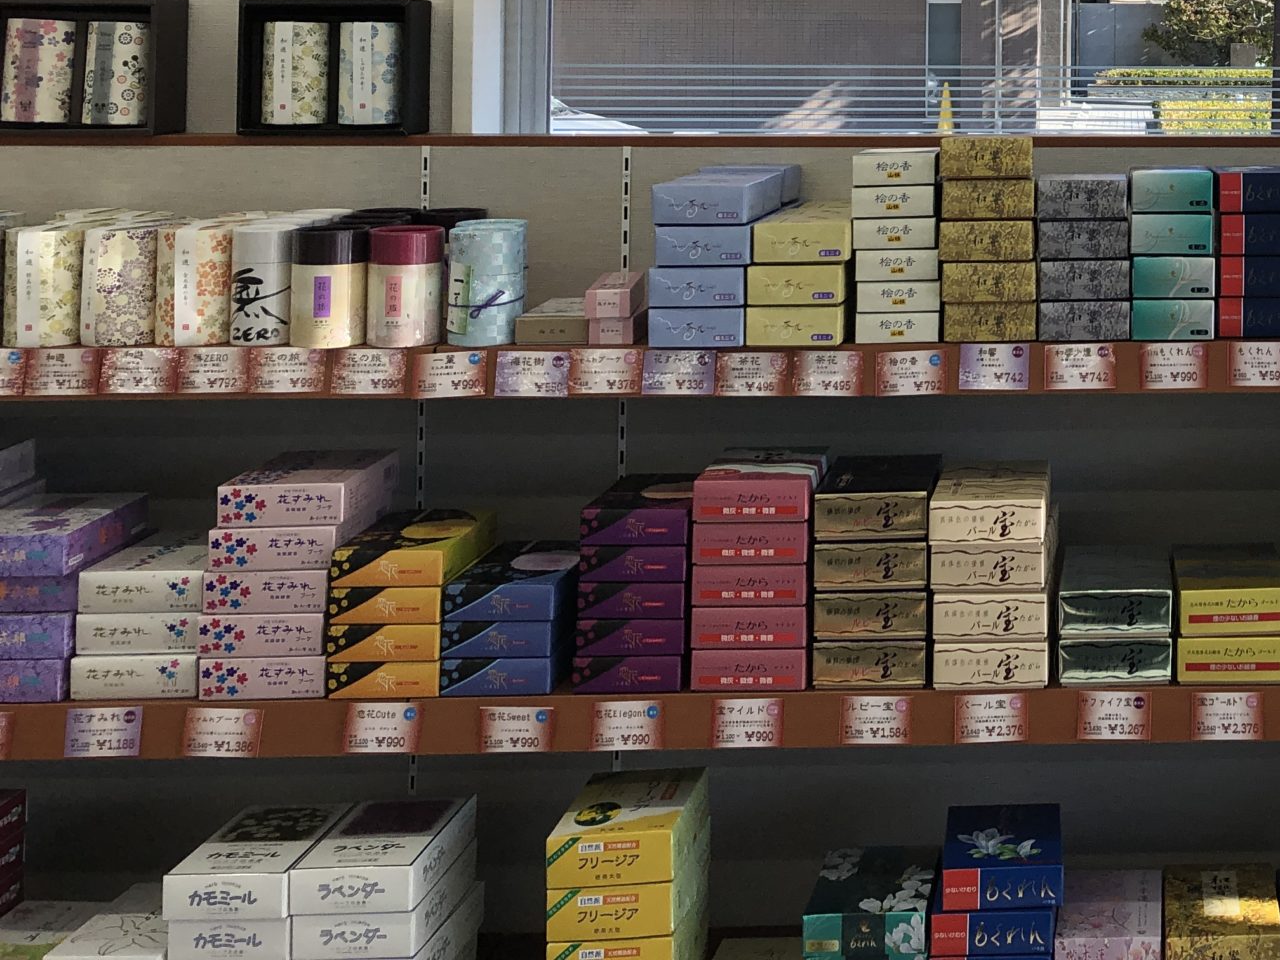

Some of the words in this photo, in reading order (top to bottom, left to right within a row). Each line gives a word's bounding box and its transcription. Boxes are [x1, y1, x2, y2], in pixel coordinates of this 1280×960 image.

[233, 268, 290, 325] 無
[232, 327, 280, 341] ZERO
[1238, 347, 1272, 356] もくれん
[264, 353, 300, 362] 花の旅
[347, 353, 382, 362] 花の旅
[738, 356, 760, 366] 茶花
[816, 355, 838, 364] 茶花
[290, 378, 318, 387] ¥990
[994, 372, 1023, 383] ¥742
[1079, 372, 1108, 382] ¥742
[1170, 372, 1198, 382] ¥990
[370, 378, 400, 388] ¥990
[451, 379, 479, 390] ¥990
[746, 381, 774, 392] ¥495
[822, 380, 851, 390] ¥495
[914, 381, 942, 391] ¥792
[278, 494, 332, 505] 花すみれ
[737, 493, 770, 504] たから
[877, 502, 898, 528] 宝
[269, 538, 324, 548] 花すみれ
[736, 535, 768, 545] たから
[876, 552, 898, 579] 宝
[263, 582, 314, 592] 花すみれ
[736, 578, 768, 587] たから
[876, 603, 897, 629] 宝
[1121, 600, 1143, 626] 宝
[257, 625, 311, 635] 花すみれ
[735, 621, 768, 631] たから
[1121, 648, 1142, 675] 宝
[258, 668, 314, 678] 花すみれ
[734, 664, 768, 674] たから
[848, 702, 894, 712] ルビー宝
[960, 700, 1006, 709] パール宝
[1082, 698, 1132, 708] サファイア宝
[716, 705, 765, 716] 宝マイルド
[72, 713, 120, 724] 花すみれ
[870, 728, 906, 738] ¥1,584
[985, 724, 1024, 736] ¥2,376
[1108, 724, 1146, 736] ¥3,267
[1222, 723, 1259, 734] ¥2,376
[375, 736, 406, 748] ¥990
[620, 734, 650, 745] ¥990
[745, 731, 774, 742] ¥990
[96, 740, 135, 751] ¥1,188
[214, 740, 253, 752] ¥1,386
[510, 737, 539, 748] ¥990
[333, 842, 406, 854] ラベンダー
[580, 844, 602, 852] 自然派
[206, 849, 281, 861] カモミール
[578, 854, 640, 870] フリージア
[318, 882, 386, 900] ラベンダー
[987, 877, 1056, 901] もくれん
[189, 890, 257, 907] カモミール
[580, 897, 600, 905] 自然派
[578, 908, 639, 924] フリージア
[320, 928, 388, 945] ラベンダー
[976, 922, 1044, 948] もくれん
[193, 933, 262, 950] カモミール
